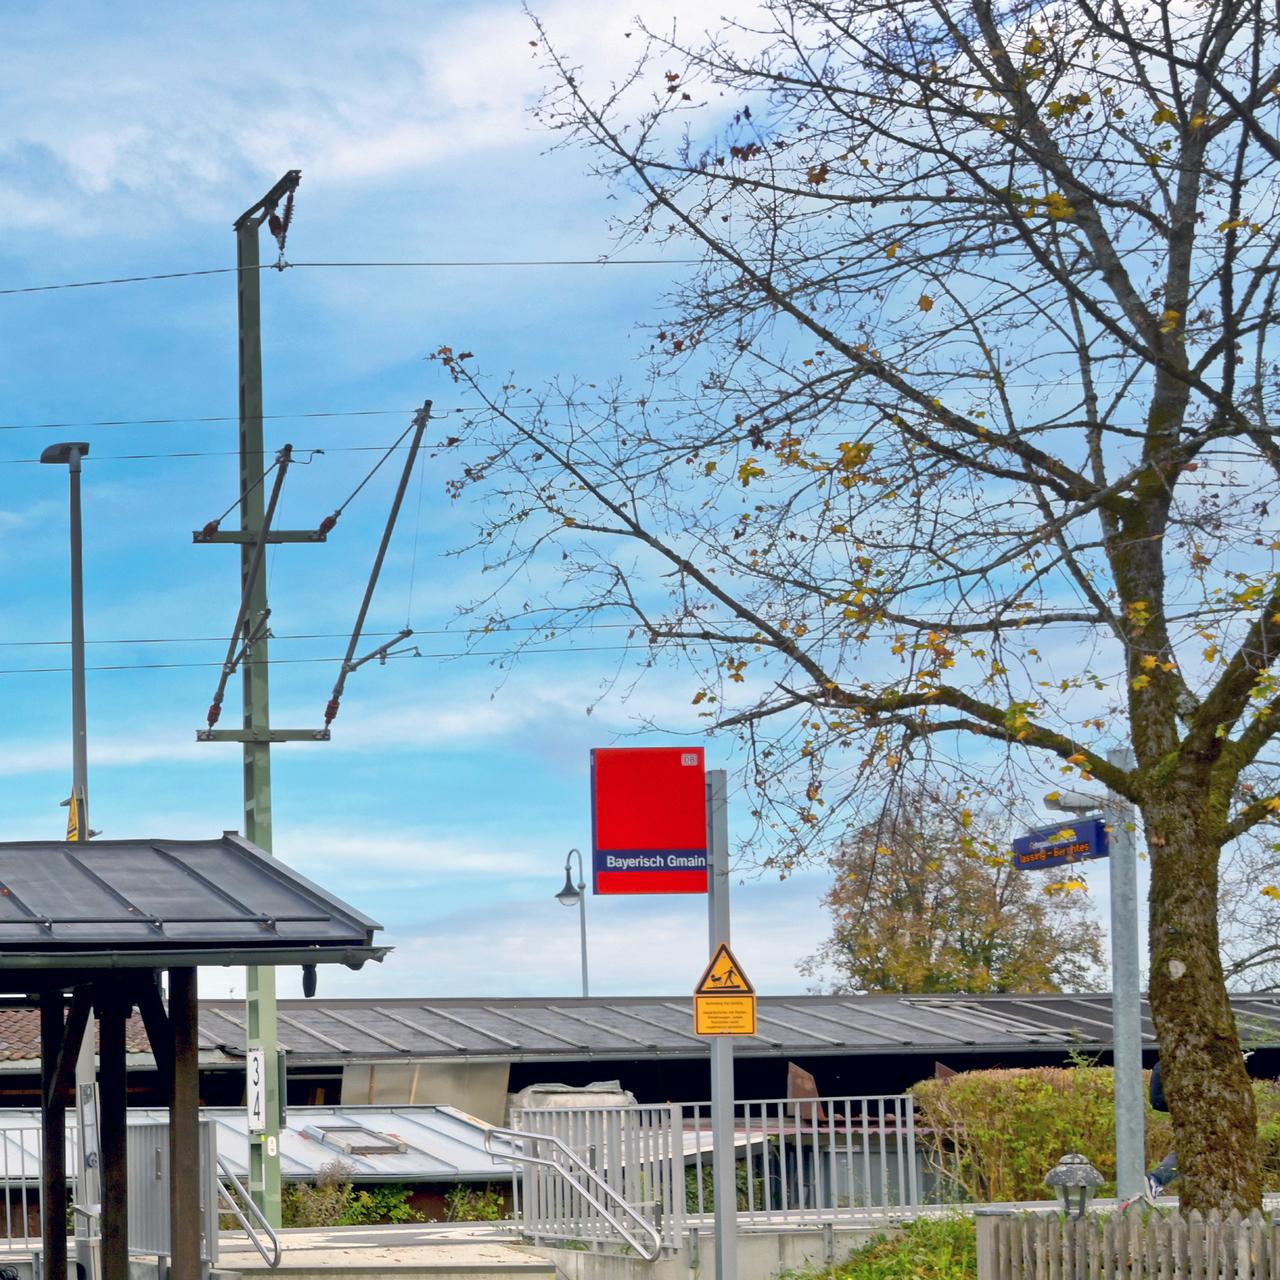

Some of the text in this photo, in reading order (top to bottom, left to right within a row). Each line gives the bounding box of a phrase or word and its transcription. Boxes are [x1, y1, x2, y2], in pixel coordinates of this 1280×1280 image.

[606, 855, 706, 870] Bayerisch Gmain
[252, 1056, 260, 1087] 3
[253, 1091, 261, 1121] 4
